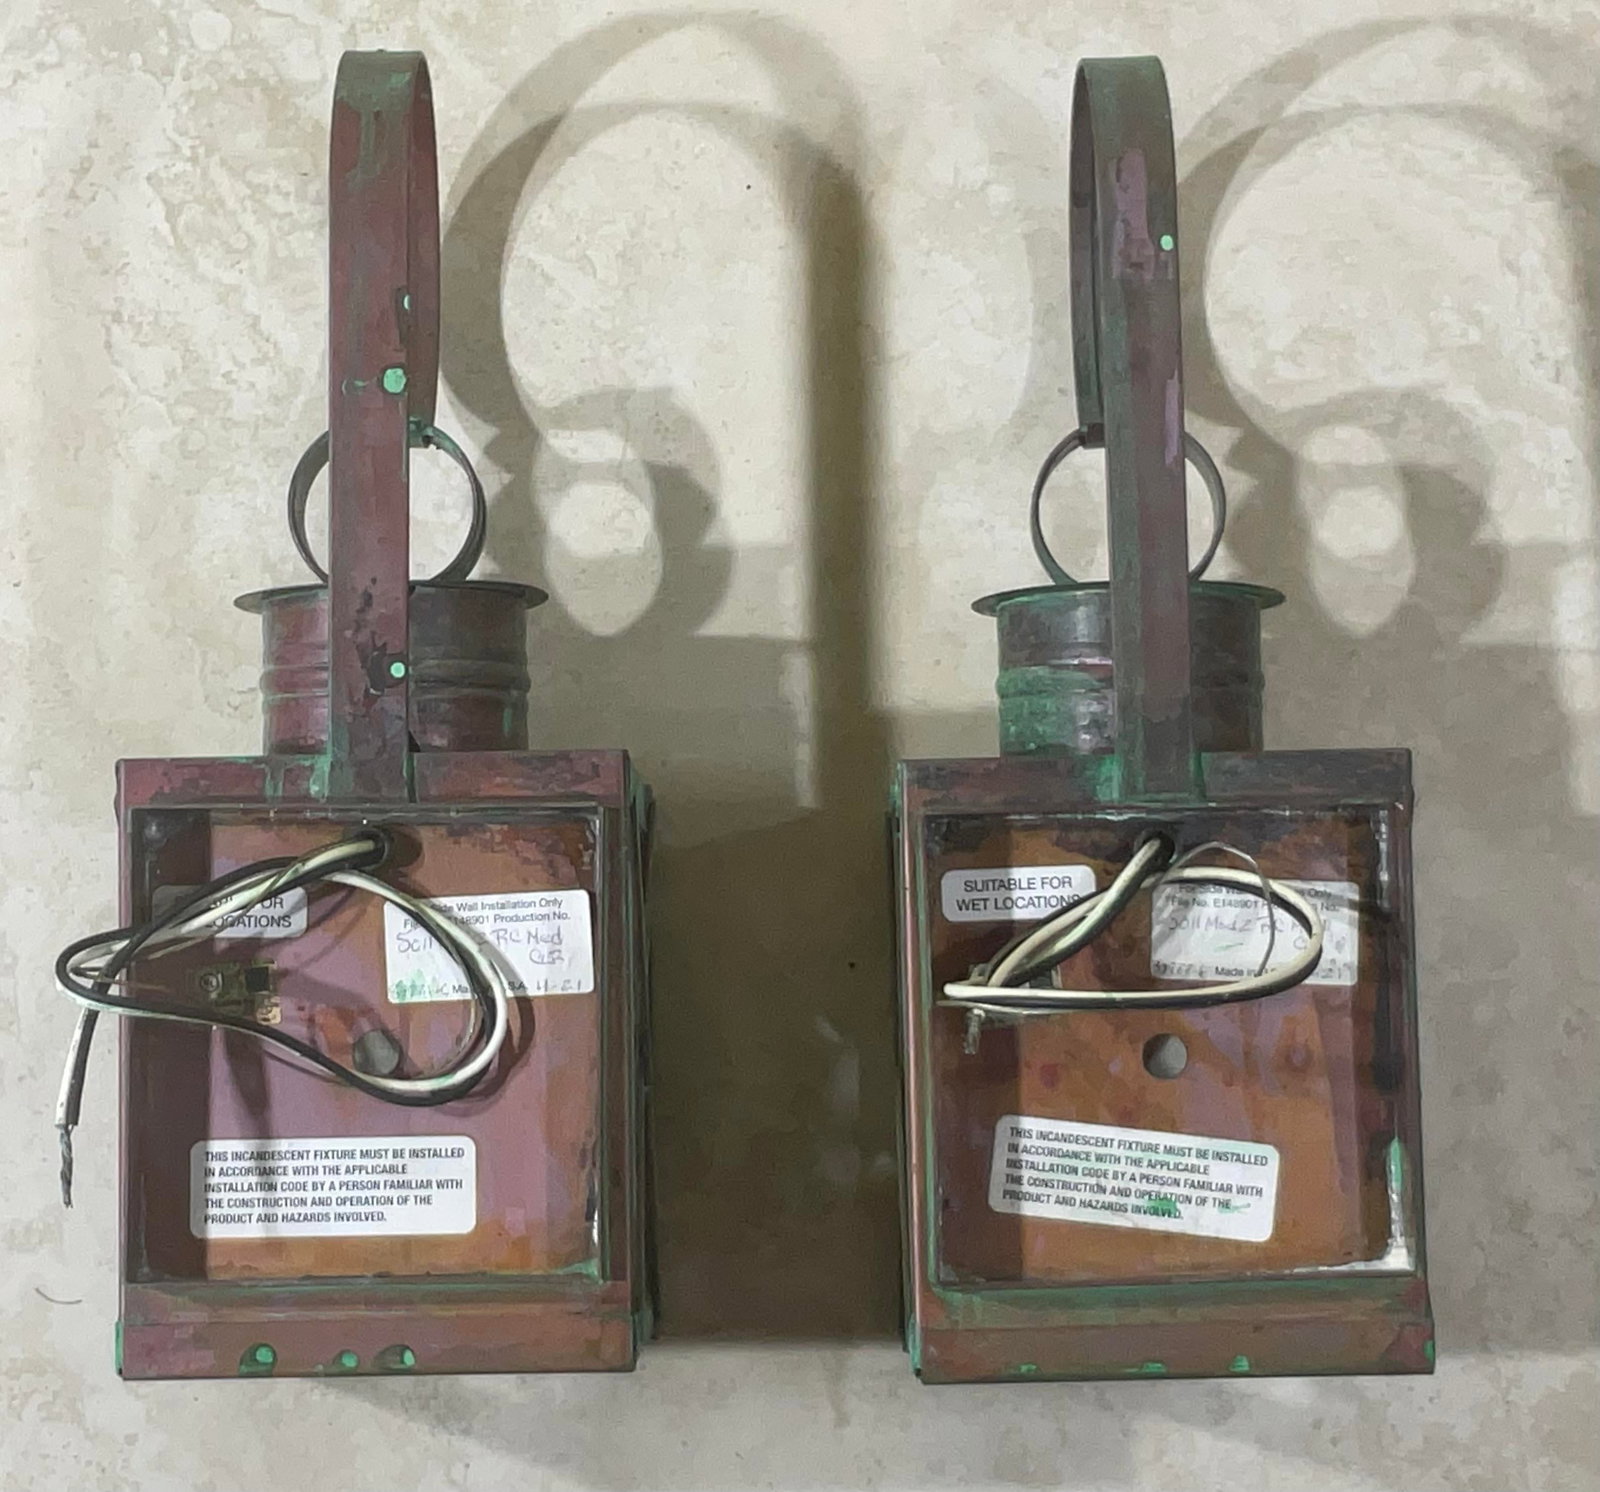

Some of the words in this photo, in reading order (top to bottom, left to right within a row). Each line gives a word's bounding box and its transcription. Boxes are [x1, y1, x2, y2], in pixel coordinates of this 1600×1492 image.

[964, 877, 1036, 893] SUITABLE
[1041, 876, 1072, 890] FOR
[455, 901, 478, 912] Wall
[481, 899, 536, 911] Installation
[539, 897, 563, 910] Only
[956, 897, 989, 912] WET
[205, 914, 292, 929] OCATIONS
[494, 912, 551, 924] Production
[553, 911, 571, 921] No.
[205, 1151, 228, 1161] THIS
[232, 1150, 310, 1161] INCANDESCENT
[314, 1149, 356, 1160] FIXTURE
[360, 1149, 389, 1160] MUST
[392, 1148, 405, 1159] BE
[409, 1147, 464, 1159] INSTALLED
[1010, 1127, 1033, 1139] THIS
[1036, 1130, 1115, 1149] INCANDESCENT
[1118, 1139, 1160, 1154] FIXTURE
[1163, 1144, 1193, 1158] MUST
[1196, 1148, 1210, 1160] BE
[1212, 1150, 1268, 1166] INSTALLED
[1008, 1142, 1019, 1153] IN
[1021, 1144, 1092, 1162] ACCORDANCE
[1094, 1152, 1121, 1165] WITH
[1124, 1156, 1143, 1168] THE
[1147, 1159, 1210, 1176] APPLICABLE
[204, 1167, 215, 1177] IN
[219, 1166, 288, 1177] ACCORDANCE
[292, 1165, 318, 1176] WITH
[322, 1165, 341, 1176] THE
[345, 1164, 407, 1175] APPLICABLE
[1006, 1158, 1078, 1176] INSTALLATION
[1082, 1166, 1109, 1179] CODE
[1112, 1170, 1127, 1181] BY
[1129, 1172, 1136, 1182] A
[1139, 1173, 1181, 1188] PERSON
[1184, 1178, 1233, 1194] FAMILIAR
[1236, 1183, 1263, 1197] WITH
[204, 1182, 277, 1193] INSTALLATION
[281, 1181, 308, 1192] CODE
[312, 1181, 325, 1192] BY
[329, 1181, 336, 1191] A
[339, 1180, 380, 1191] PERSON
[384, 1179, 433, 1190] FAMILIAR
[436, 1179, 463, 1189] WITH
[1005, 1173, 1024, 1185] THE
[1027, 1176, 1107, 1195] CONSTRUCTION
[1109, 1185, 1131, 1198] AND
[1134, 1188, 1192, 1205] OPERATION
[1195, 1195, 1209, 1207] OF
[1212, 1197, 1231, 1209] THE
[205, 1198, 224, 1209] THE
[227, 1197, 307, 1209] CONSTRUCTION
[311, 1197, 332, 1207] AND
[336, 1196, 394, 1207] OPERATION
[397, 1195, 410, 1206] OF
[414, 1195, 433, 1205] THE
[1003, 1189, 1052, 1204] PRODUCT
[1054, 1194, 1076, 1207] AND
[1079, 1198, 1128, 1213] HAZARDS
[204, 1213, 254, 1224] PRODUCT
[256, 1213, 278, 1224] AND
[282, 1212, 331, 1223] HAZARDS
[334, 1211, 387, 1222] INVOLVED.
